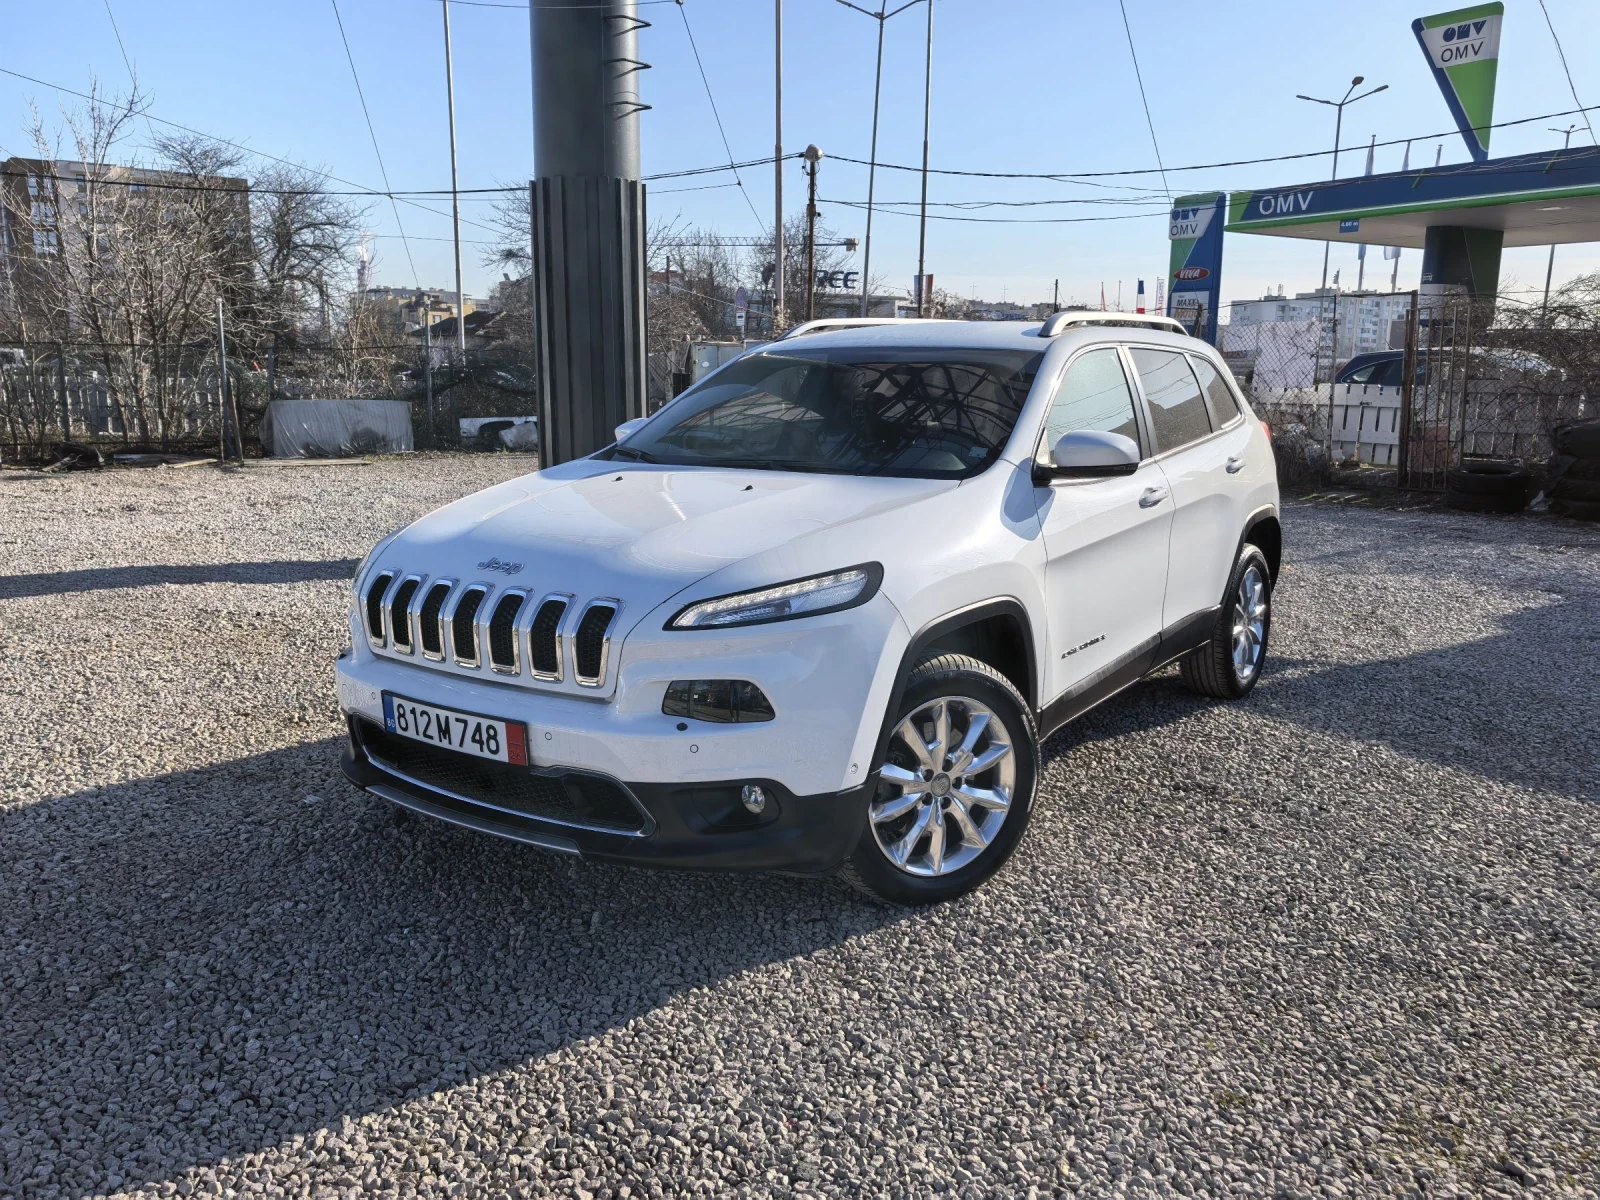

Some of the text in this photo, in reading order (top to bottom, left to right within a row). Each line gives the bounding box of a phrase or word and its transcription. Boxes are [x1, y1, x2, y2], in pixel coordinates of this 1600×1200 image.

[1441, 41, 1484, 63] OMV
[1259, 191, 1314, 215] OMV
[1171, 223, 1199, 237] OMV
[1180, 268, 1201, 279] VIVA
[477, 556, 524, 576] Jeep
[386, 717, 396, 729] BG
[396, 703, 500, 755] 812M748
